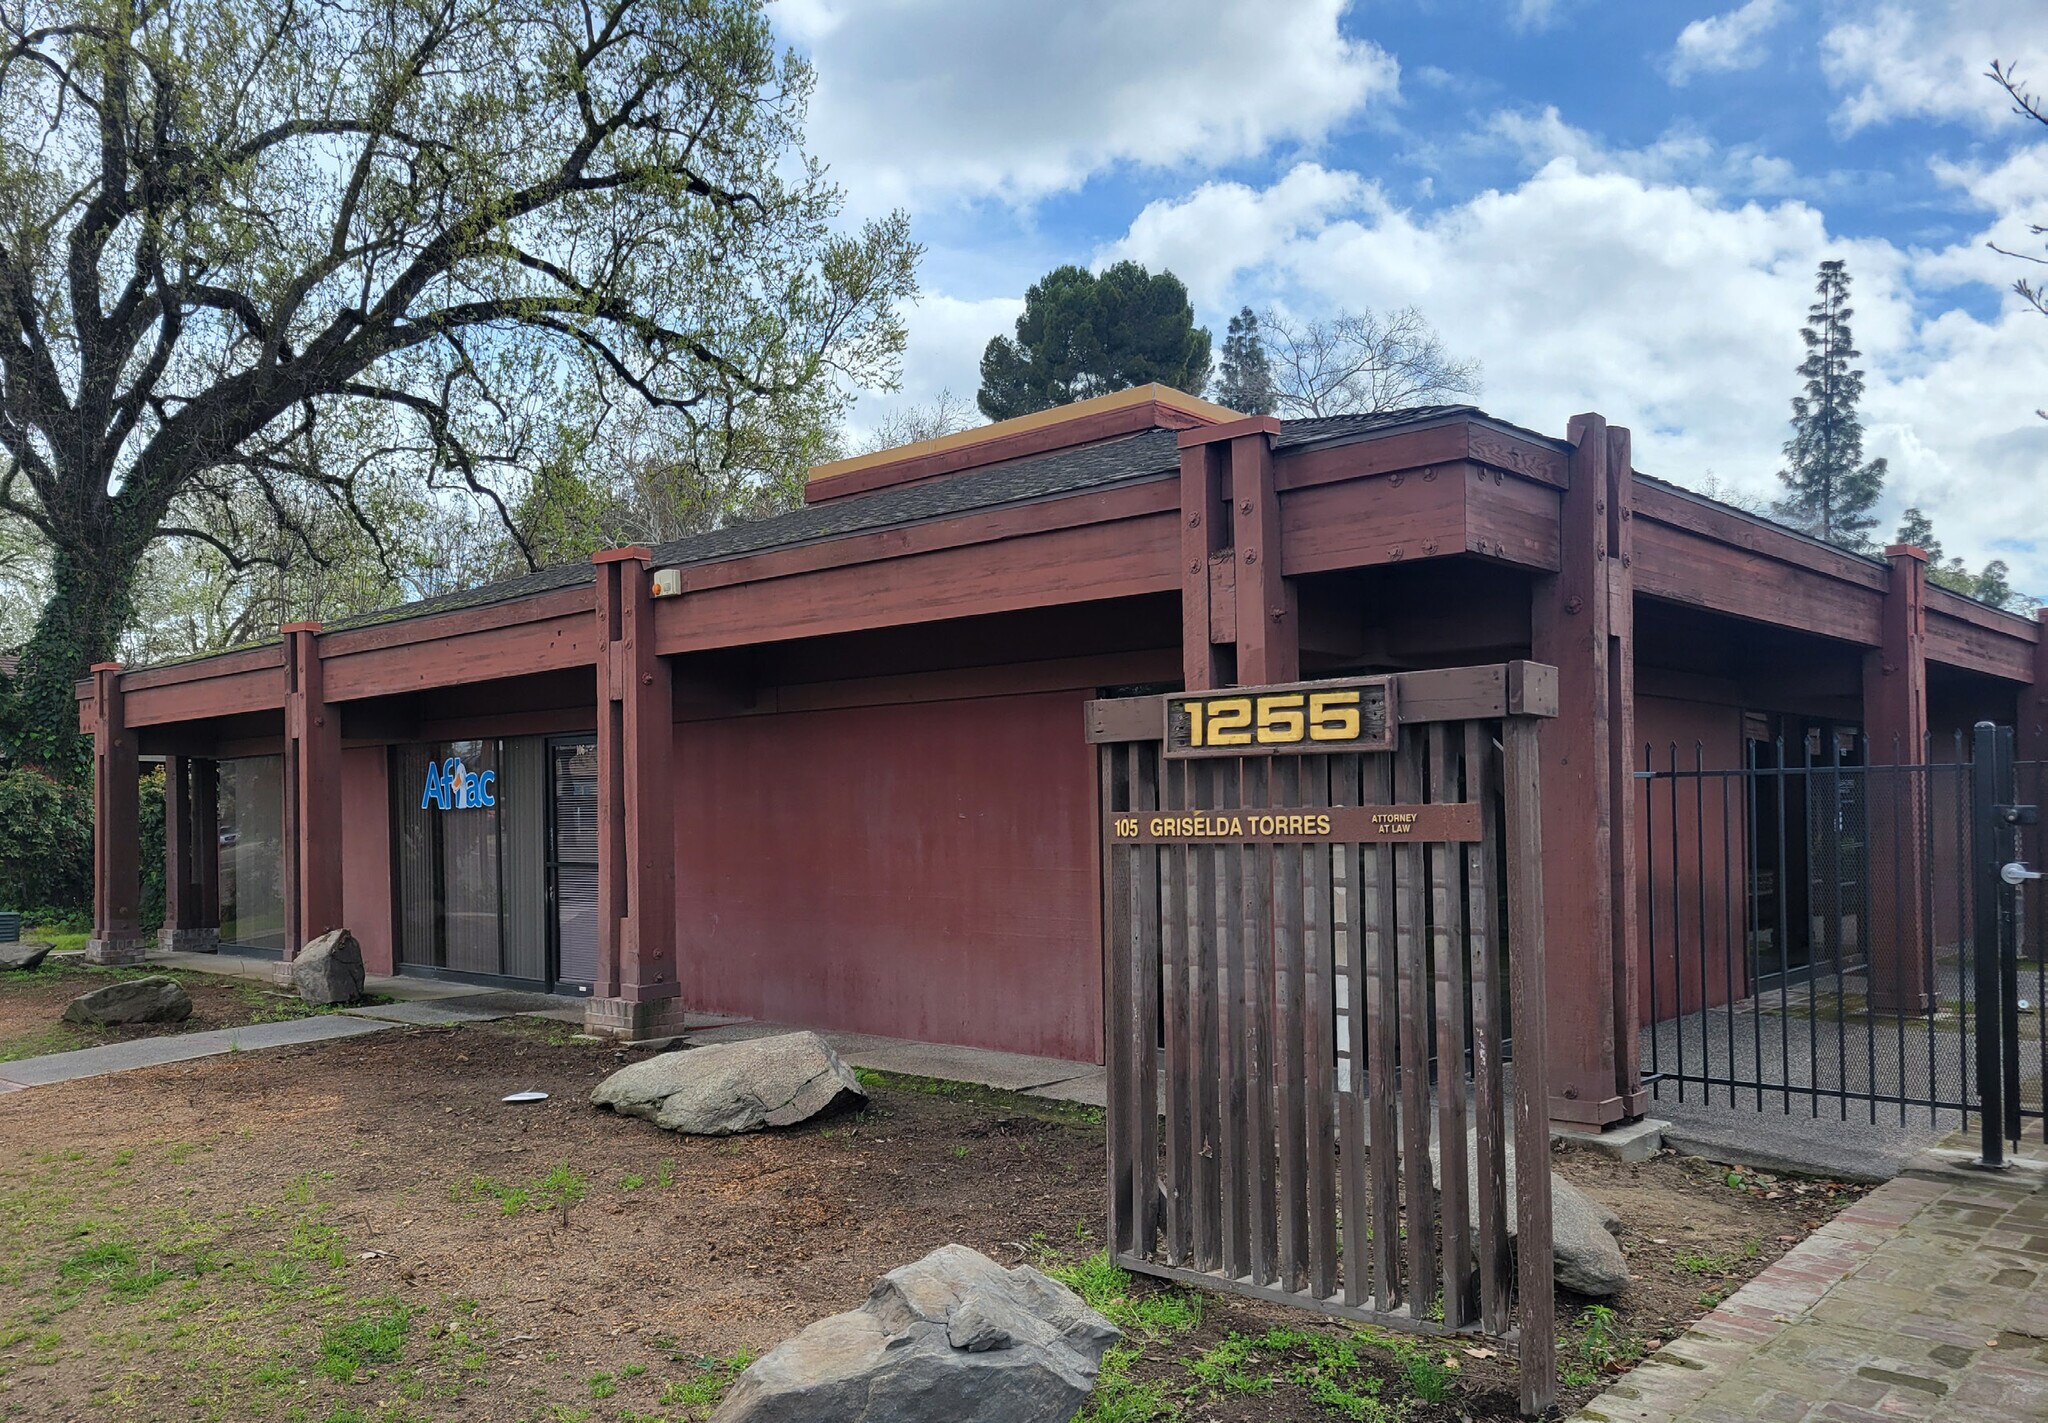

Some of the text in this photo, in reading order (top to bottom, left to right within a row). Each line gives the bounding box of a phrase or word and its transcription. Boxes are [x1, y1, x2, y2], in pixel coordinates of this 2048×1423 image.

[1184, 691, 1361, 747] 1255
[421, 757, 496, 810] Aflac
[1114, 814, 1331, 837] 105 GRISELDA TORRES
[1371, 813, 1418, 824] ATTORNEY
[1378, 824, 1411, 834] AT LAW
